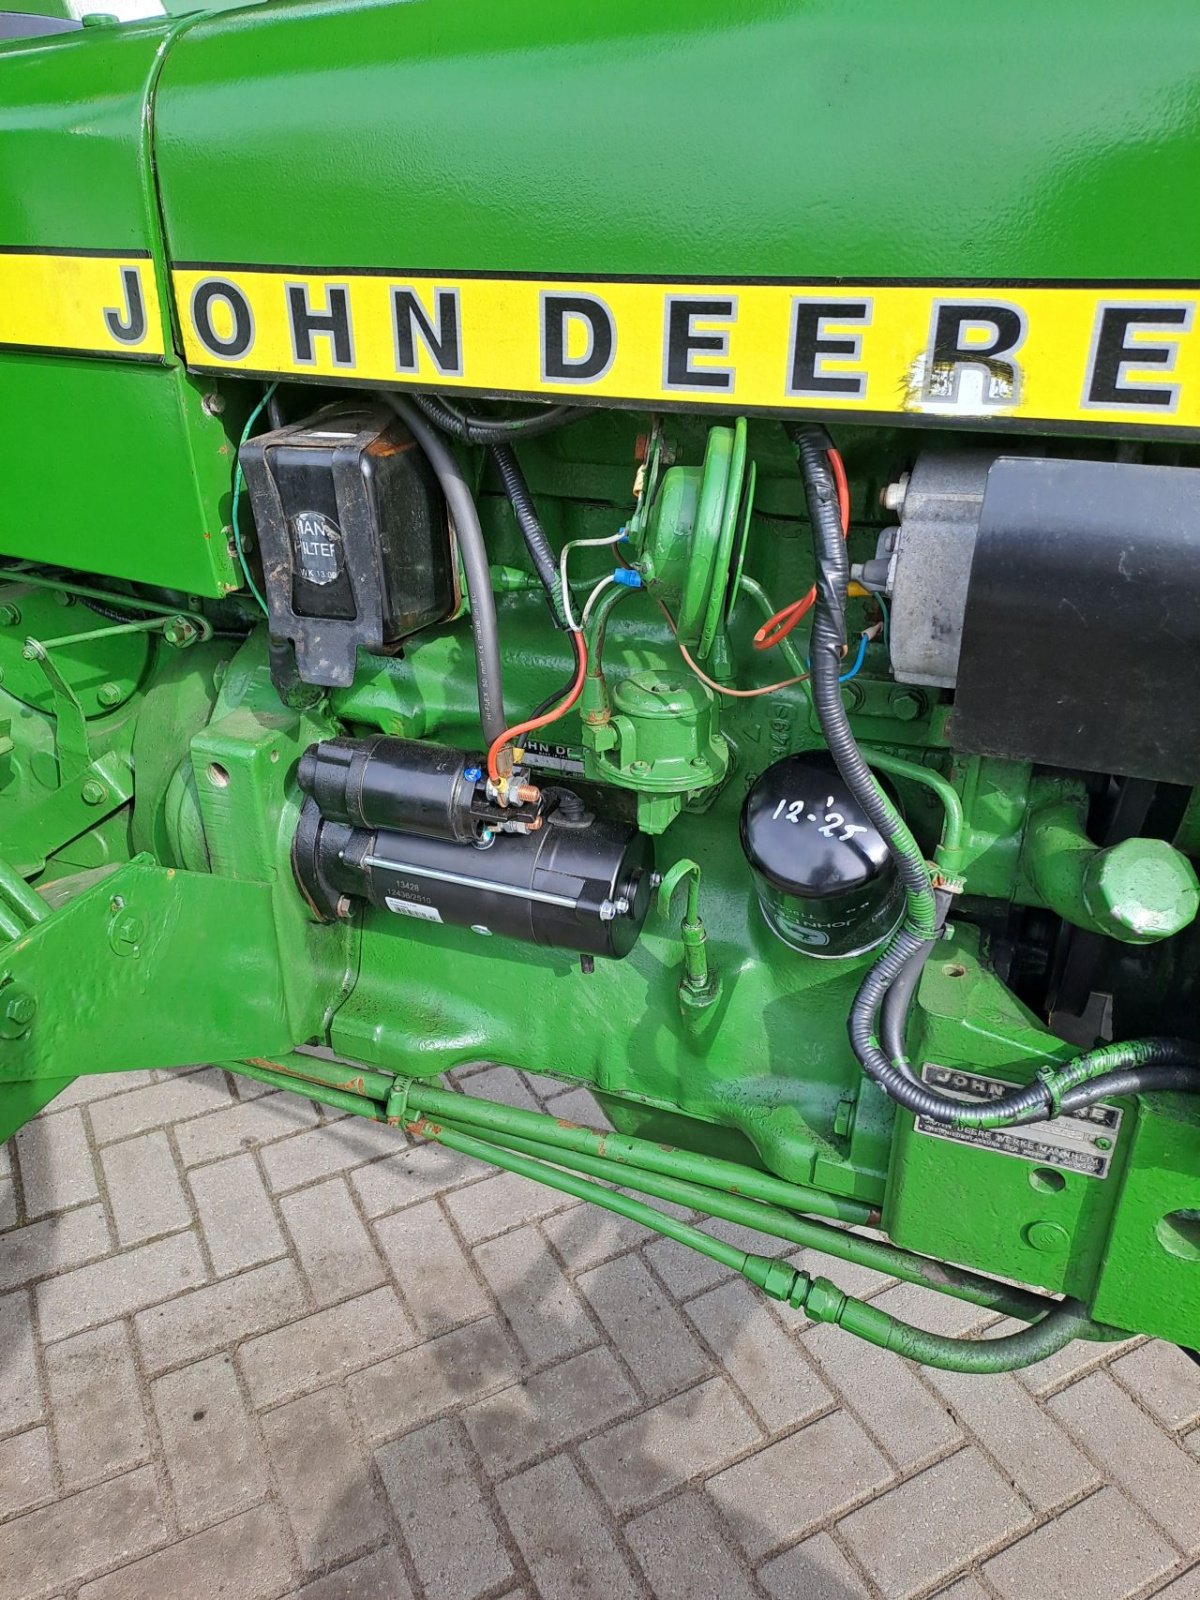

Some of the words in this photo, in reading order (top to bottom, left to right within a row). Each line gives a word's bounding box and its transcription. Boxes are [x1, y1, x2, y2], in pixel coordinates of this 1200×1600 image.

[103, 265, 465, 377] JOHN
[538, 288, 1197, 414] DEERE
[935, 1072, 1006, 1099] JOHN
